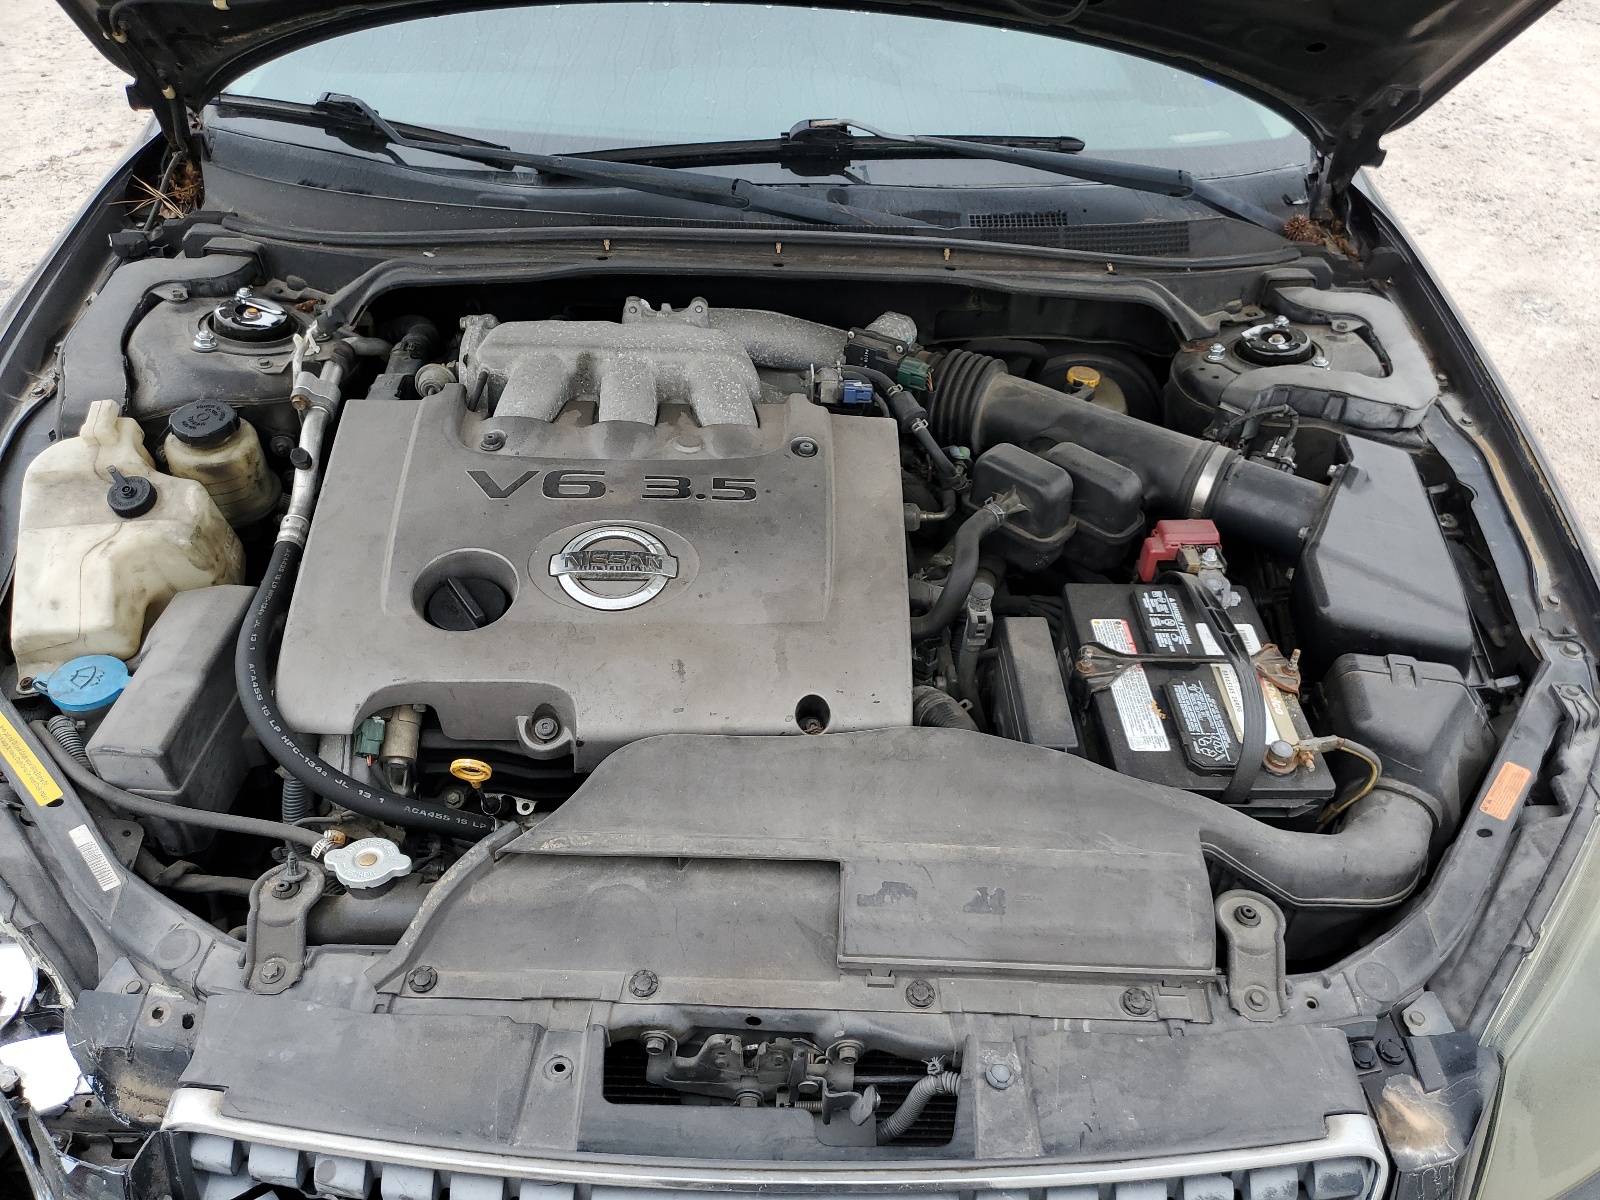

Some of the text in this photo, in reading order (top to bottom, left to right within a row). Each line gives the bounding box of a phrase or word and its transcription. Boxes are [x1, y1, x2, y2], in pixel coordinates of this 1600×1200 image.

[465, 469, 758, 502] V6 3.5
[562, 550, 665, 571] NISSAN
[269, 719, 281, 733] LP
[358, 789, 372, 799] 13
[472, 820, 487, 829] LP
